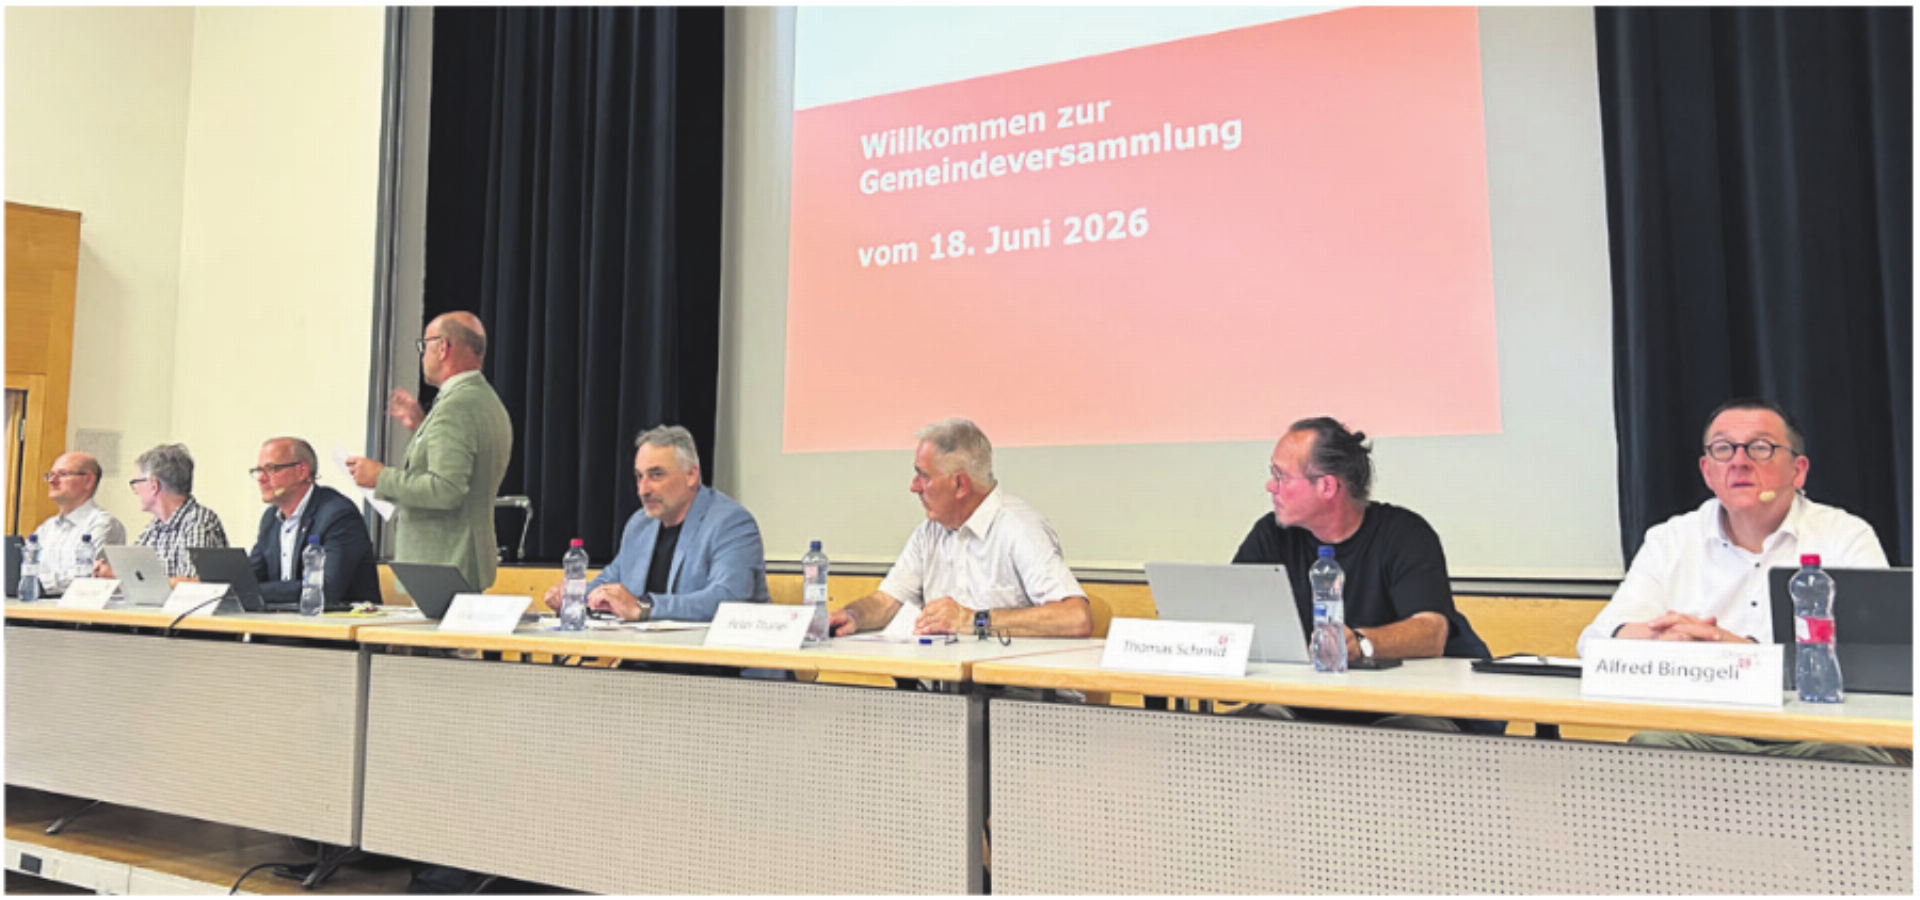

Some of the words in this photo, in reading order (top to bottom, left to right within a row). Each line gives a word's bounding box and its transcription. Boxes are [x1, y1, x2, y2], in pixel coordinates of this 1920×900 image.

[859, 119, 1242, 195] Gemeindeversammlung
[860, 111, 1046, 159] Willkommen
[1057, 100, 1111, 129] zur
[858, 238, 918, 267] vom
[930, 231, 975, 260] 18.
[985, 220, 1050, 254] Juni
[1063, 209, 1149, 245] 2026
[1124, 641, 1173, 655] Thomas
[1176, 643, 1227, 657] Schmid
[1595, 658, 1652, 675] Alfred
[1659, 661, 1739, 683] Binggeli
